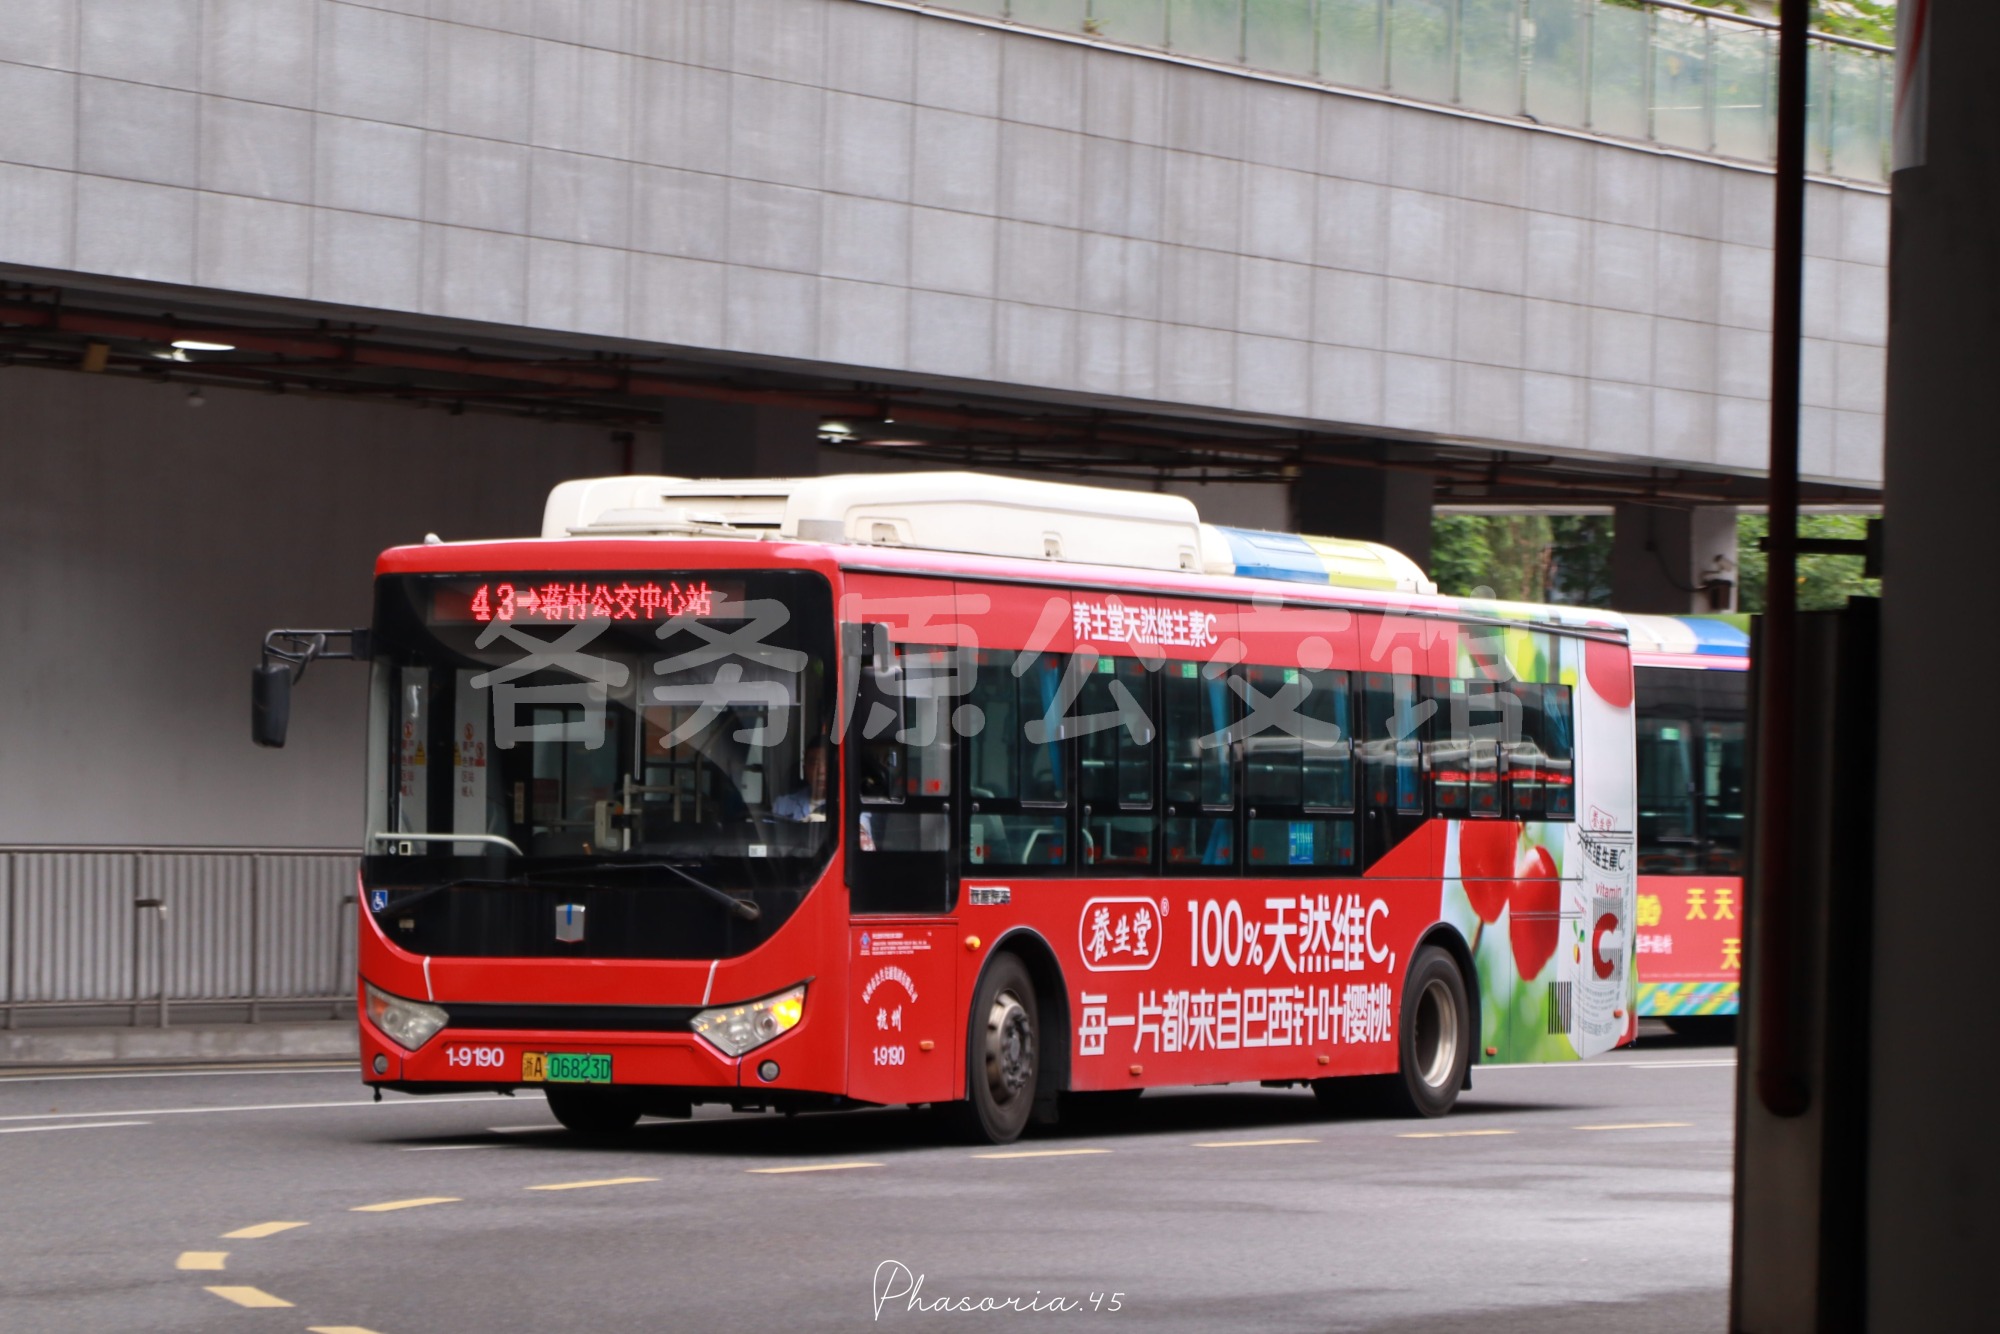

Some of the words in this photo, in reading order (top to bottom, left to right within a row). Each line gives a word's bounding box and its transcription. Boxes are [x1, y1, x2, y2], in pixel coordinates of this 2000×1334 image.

[471, 584, 515, 621] 43
[540, 581, 712, 620] 蒋村公交中心站
[1073, 601, 1218, 648] 养生堂天然维生素C
[876, 1004, 902, 1032] 杭州
[1078, 983, 1393, 1056] 每一片都来自巴西针叶樱桃
[446, 1047, 505, 1067] 1-9190
[873, 1045, 905, 1066] 1-9190
